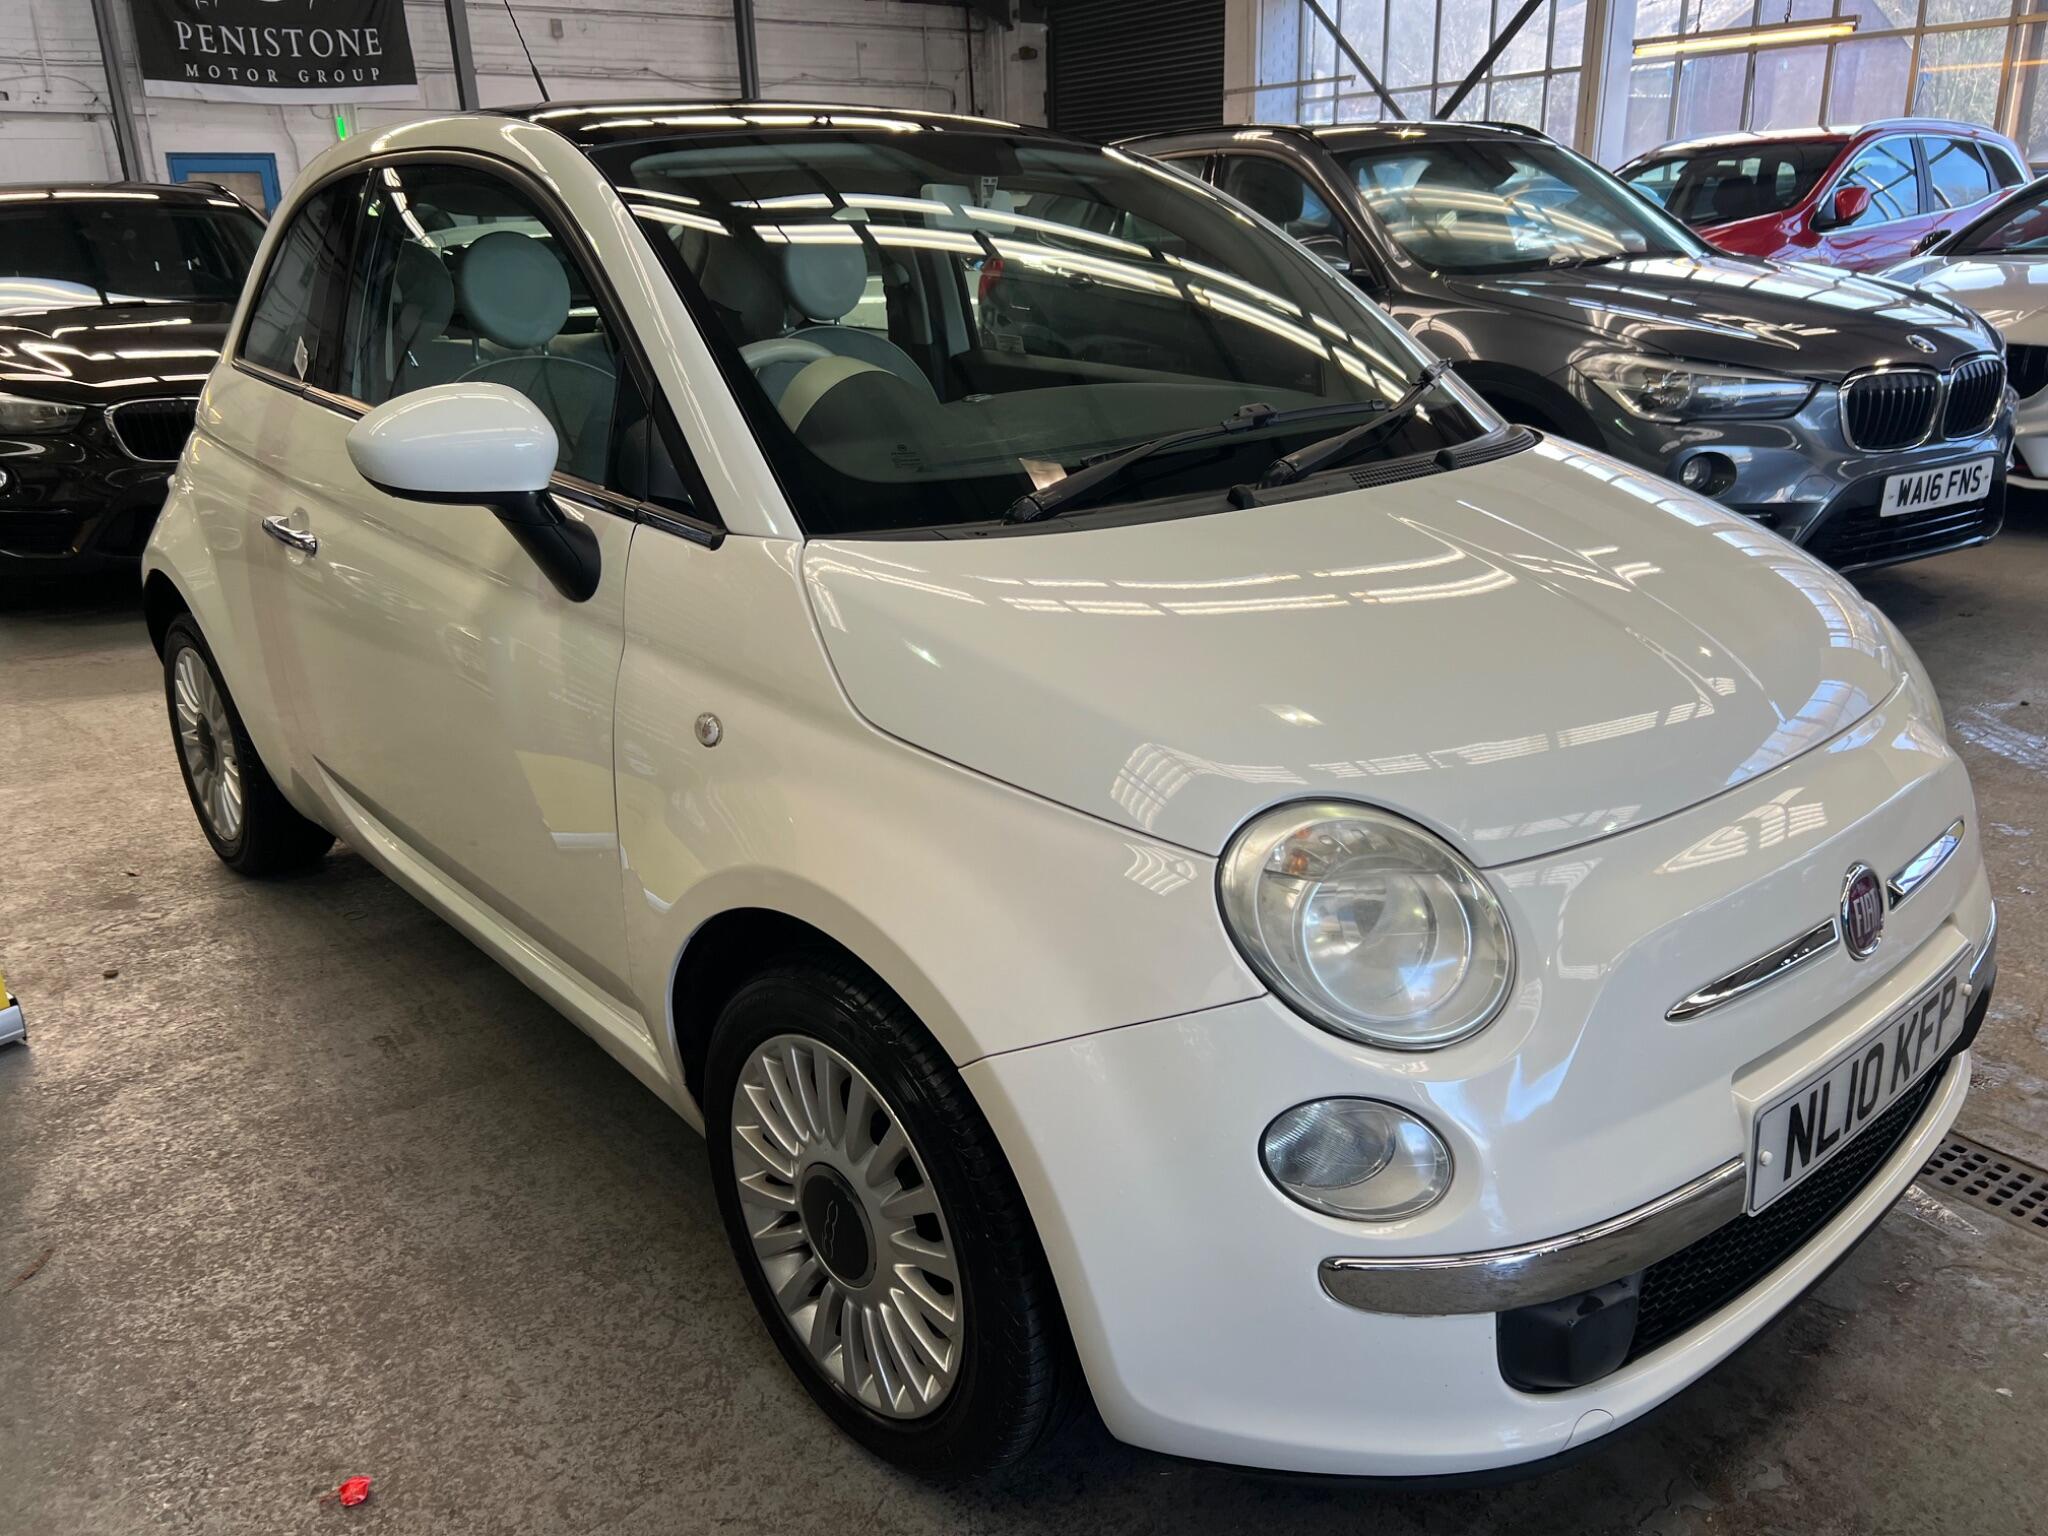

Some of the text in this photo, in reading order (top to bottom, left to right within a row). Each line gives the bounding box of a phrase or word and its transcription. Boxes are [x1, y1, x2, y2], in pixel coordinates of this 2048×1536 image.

[174, 20, 383, 57] PENISTONE
[185, 63, 380, 83] MOTOR GROUP
[1897, 465, 1982, 507] WA16 FNS
[1783, 976, 1957, 1182] NL10 KFP
